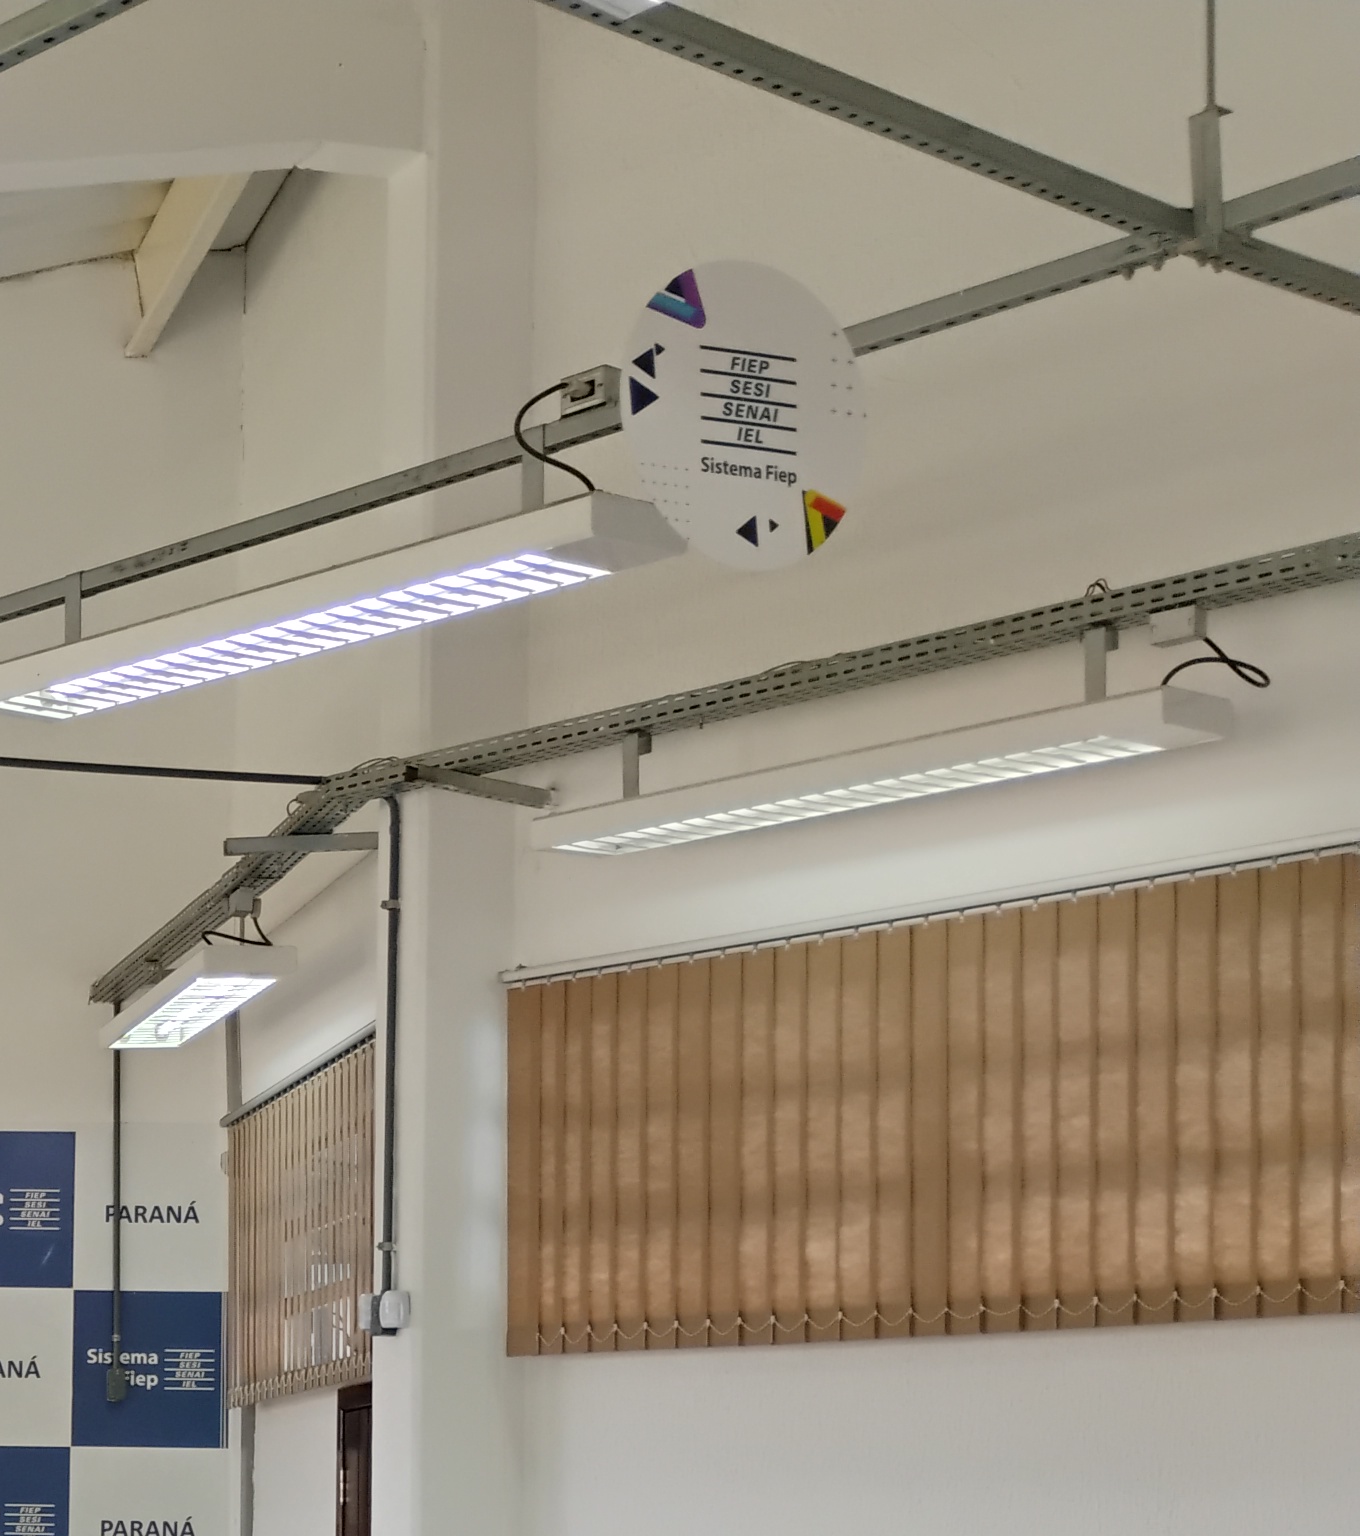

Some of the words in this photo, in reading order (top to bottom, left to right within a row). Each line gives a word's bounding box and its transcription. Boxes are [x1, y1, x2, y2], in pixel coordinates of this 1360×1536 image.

[730, 357, 770, 375] FIEP
[730, 380, 771, 398] SESI
[722, 402, 779, 422] SENAI
[737, 427, 763, 444] IEL
[701, 457, 761, 479] Sistema
[766, 464, 797, 487] Fiep
[105, 1201, 199, 1224] PARANÁ
[87, 1349, 158, 1364] Sisema
